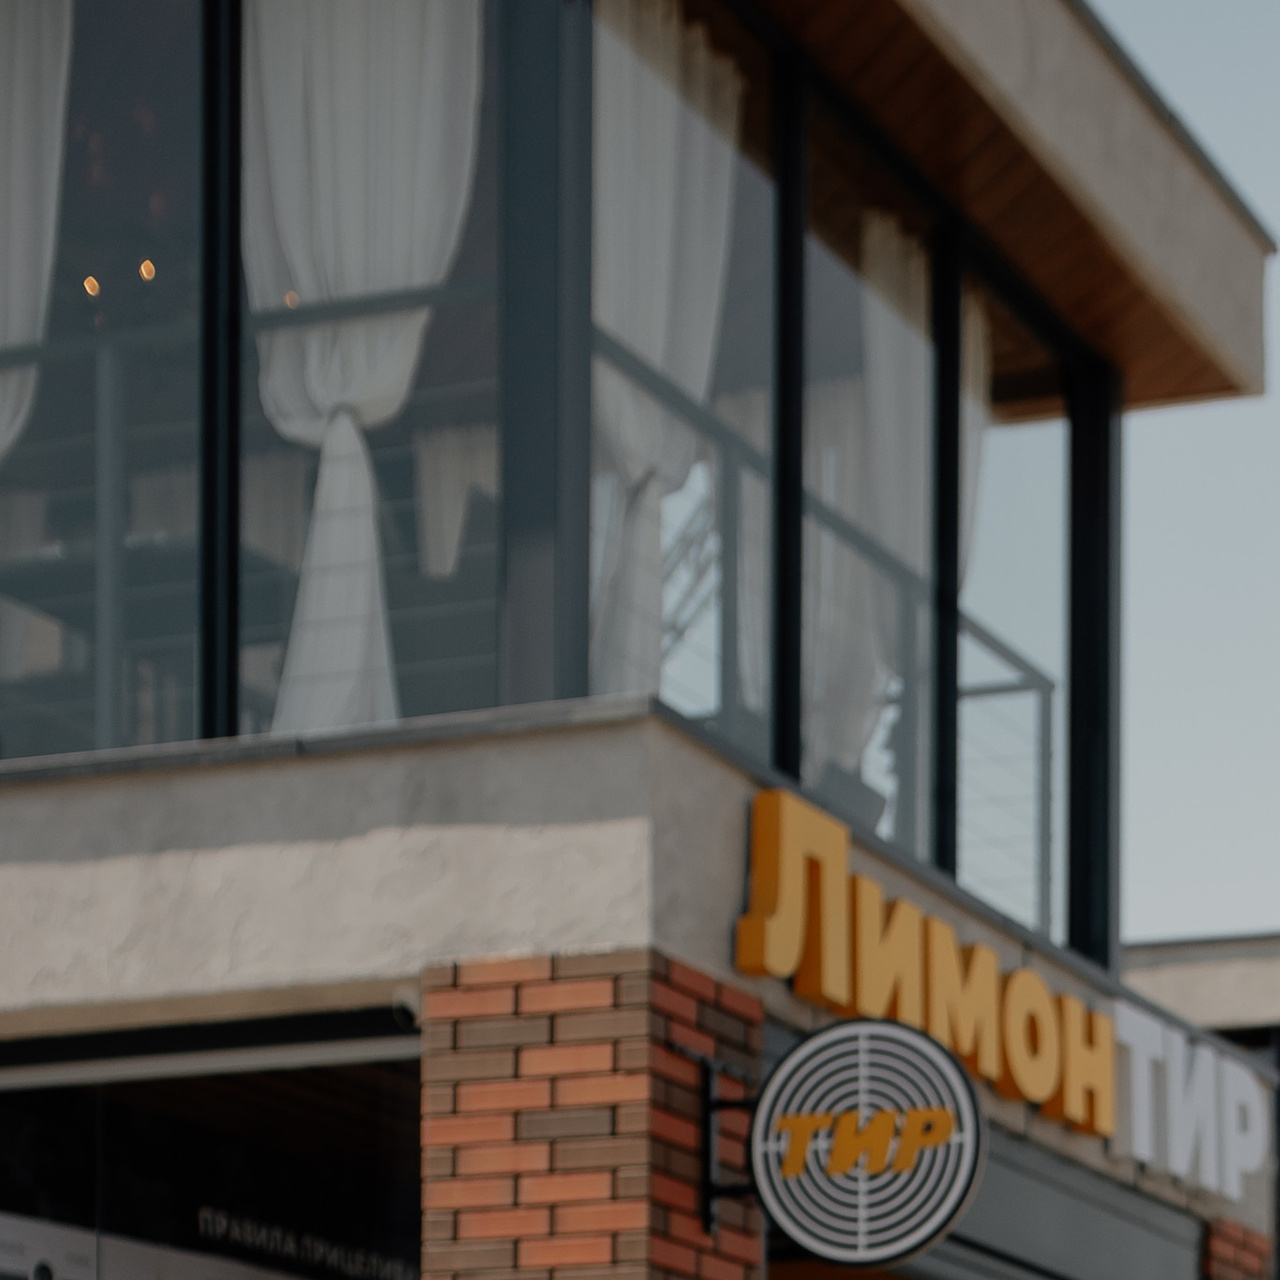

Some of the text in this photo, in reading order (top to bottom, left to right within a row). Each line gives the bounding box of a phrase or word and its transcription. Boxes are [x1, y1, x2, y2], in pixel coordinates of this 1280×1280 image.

[1114, 998, 1269, 1200] ТИР
[775, 1106, 956, 1179] ТИР
[198, 1205, 299, 1260] ПРАВИЛА
